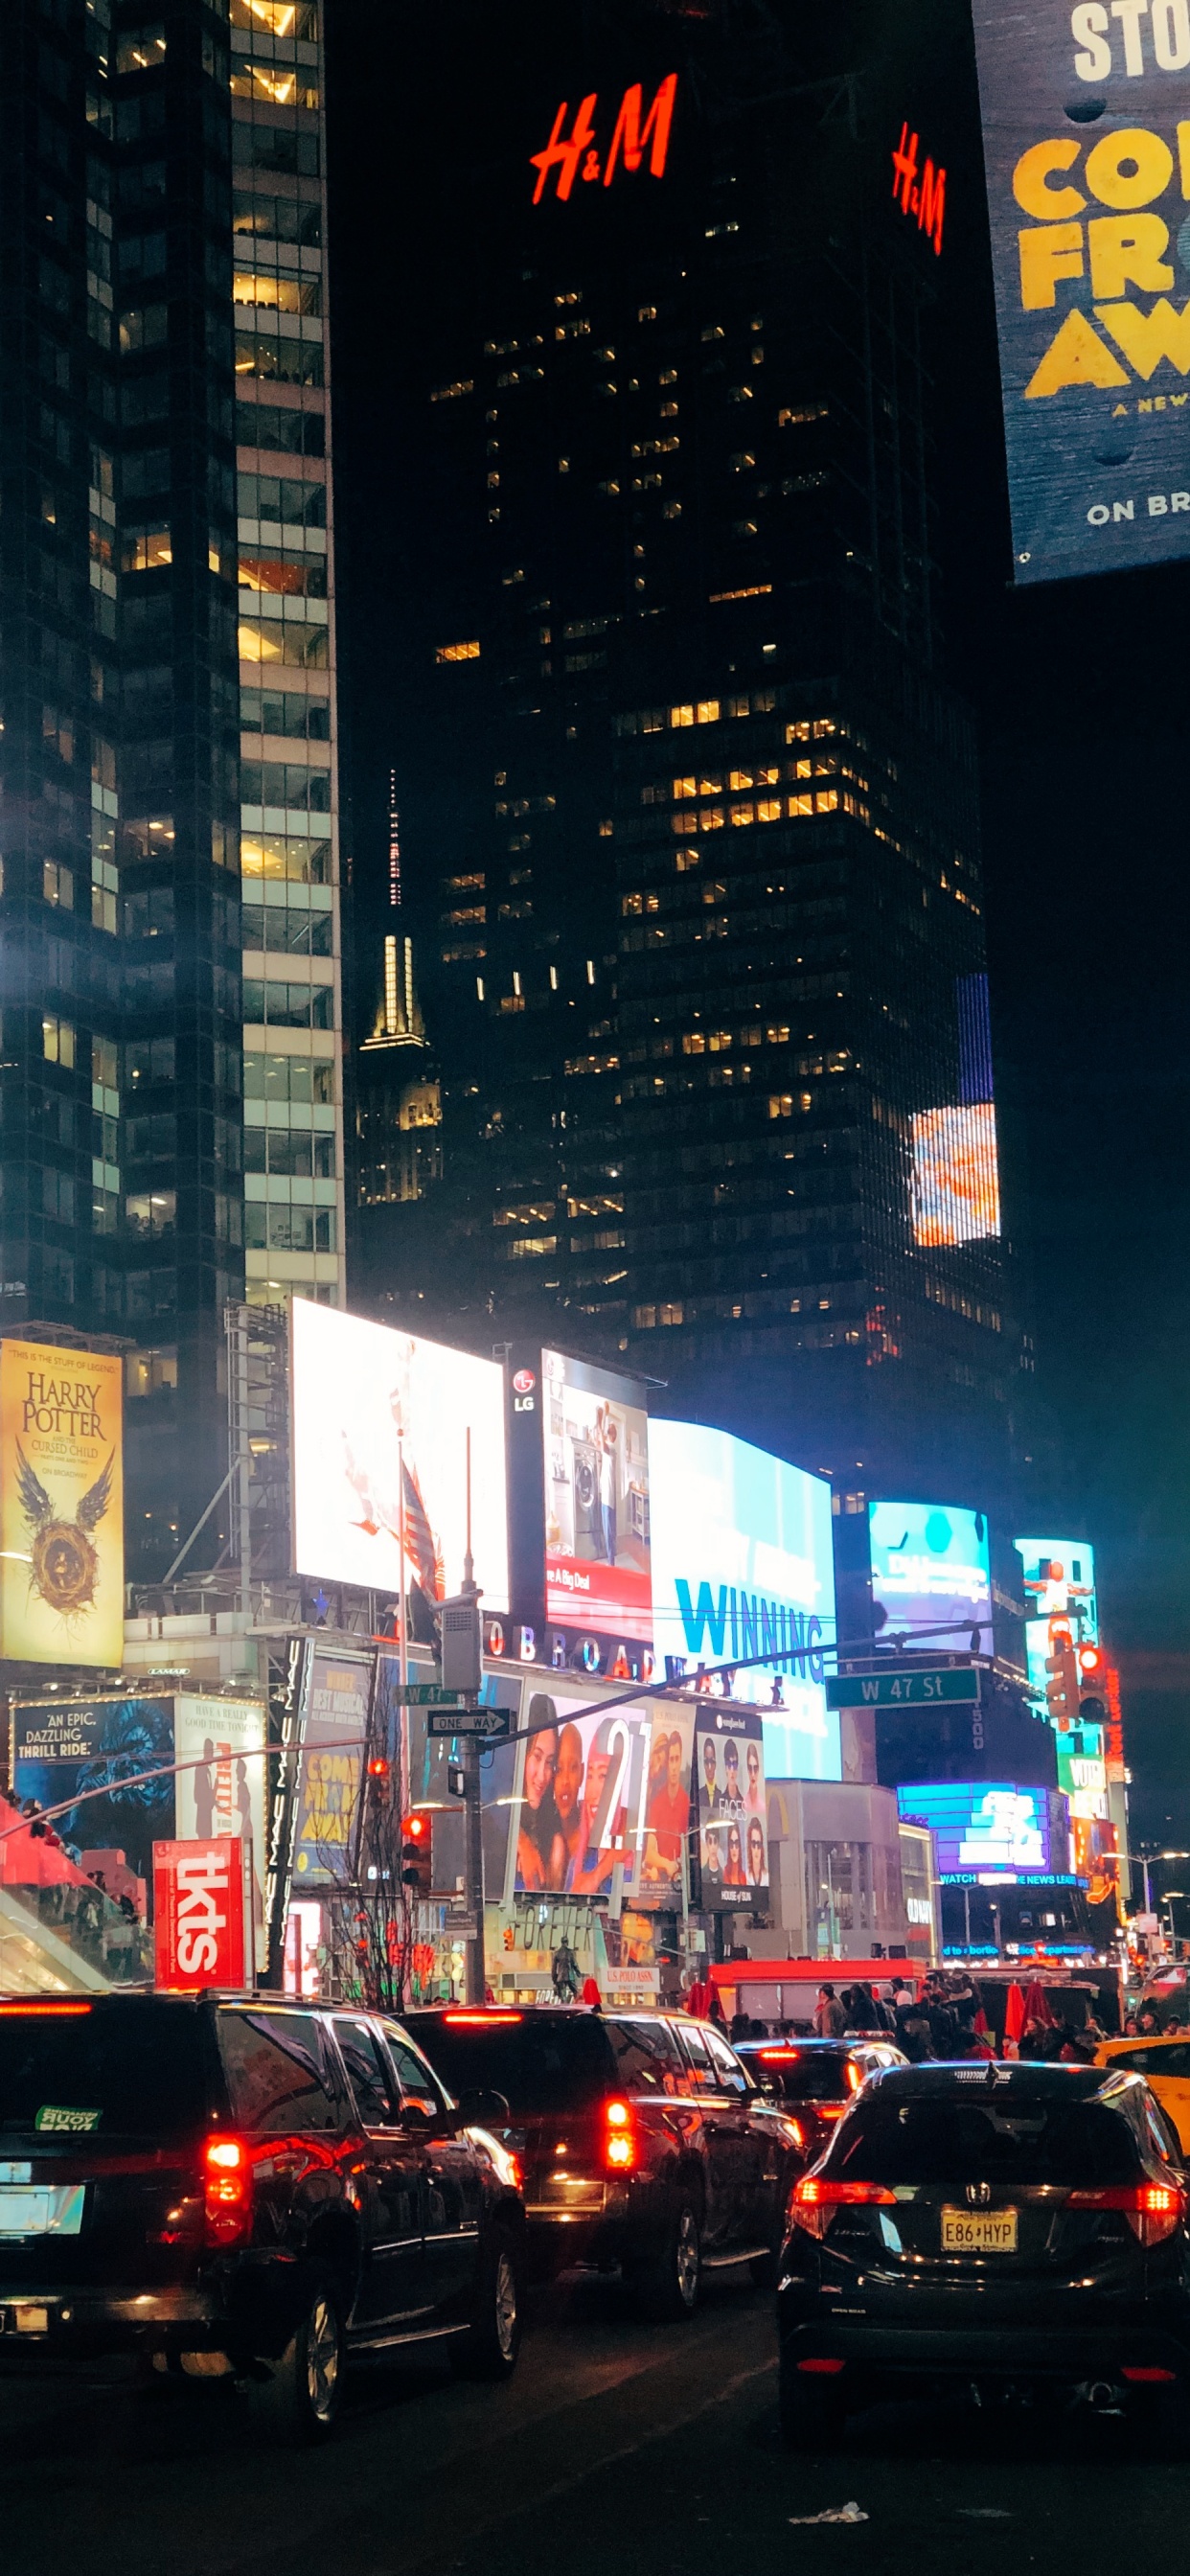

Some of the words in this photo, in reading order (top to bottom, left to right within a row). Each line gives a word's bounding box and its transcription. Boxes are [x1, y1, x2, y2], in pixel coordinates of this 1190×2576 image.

[1071, 0, 1190, 81] STO
[530, 73, 677, 205] H&M
[892, 121, 946, 256] H&M
[1111, 403, 1128, 418] A
[1138, 392, 1188, 413] NEW
[1087, 499, 1134, 525] ON
[31, 1352, 36, 1361] IS
[38, 1354, 52, 1364] THE
[54, 1357, 75, 1368] STUFF
[27, 1371, 102, 1412] HARRY
[515, 1397, 534, 1412] LG
[22, 1400, 107, 1441] POTTER
[32, 1439, 67, 1455] CURSED
[69, 1445, 98, 1459] CHILD
[675, 1578, 825, 1684] WINNING
[409, 1689, 420, 1703] W
[427, 1687, 442, 1702] 47
[862, 1682, 879, 1701] W
[891, 1678, 913, 1699] 47
[924, 1676, 943, 1697] St
[185, 1717, 206, 1729] GOOD
[209, 1720, 225, 1731] TIME
[196, 1705, 214, 1716] HAVE
[217, 1709, 221, 1717] A
[223, 1709, 247, 1720] REALLY
[440, 1718, 462, 1729] ONE
[473, 1717, 497, 1728] WAY
[26, 1728, 82, 1743] DAZZLING
[18, 1744, 57, 1759] THRILL
[308, 1753, 359, 1782] COME
[599, 1718, 652, 1851] 21
[719, 1798, 747, 1821] FACES
[940, 1874, 976, 1884] WATCH
[1026, 1875, 1055, 1884] NEWS
[721, 1891, 737, 1901] HOUSE
[742, 1892, 751, 1901] SUN
[176, 1852, 228, 1974] tkts
[513, 1904, 592, 1951] FOREVER
[620, 1970, 635, 1982] POLO
